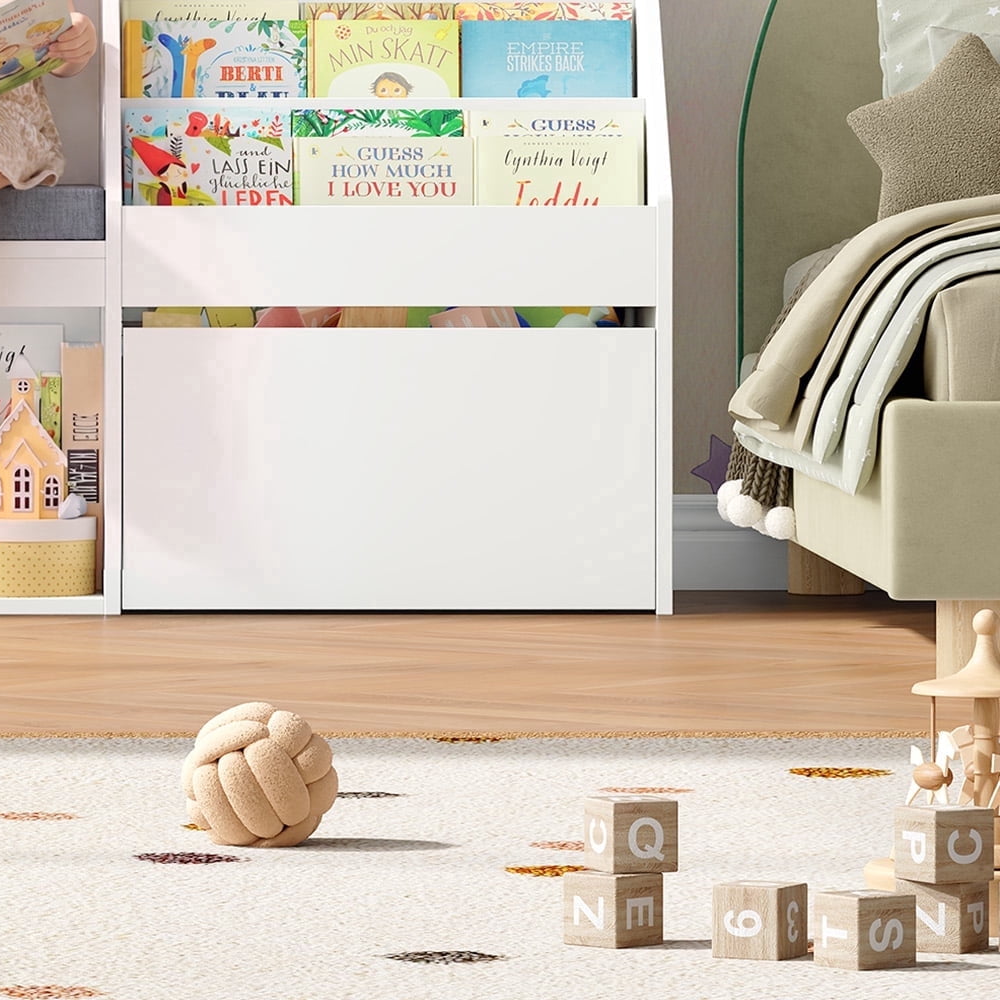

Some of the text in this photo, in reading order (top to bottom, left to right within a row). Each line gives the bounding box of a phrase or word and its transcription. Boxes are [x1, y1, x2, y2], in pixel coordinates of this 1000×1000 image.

[328, 37, 454, 72] MIN SKATT
[507, 41, 585, 55] EMPIRE
[219, 65, 284, 81] BERTI
[507, 54, 585, 72] STRIKES BACK
[531, 119, 596, 131] GUESS
[236, 146, 272, 156] und
[357, 147, 424, 161] GUESS
[211, 158, 249, 175] LASS
[332, 164, 452, 178] HOW MUCH
[505, 149, 607, 175] Cynthia Voigt
[209, 174, 292, 194] glückliche
[327, 181, 457, 197] I LOVE YOU
[628, 816, 665, 861] Q
[902, 830, 926, 865] P
[947, 828, 983, 865] C
[626, 896, 654, 931] E
[967, 901, 985, 935] P
[821, 914, 848, 949] T
[869, 918, 904, 952] S
